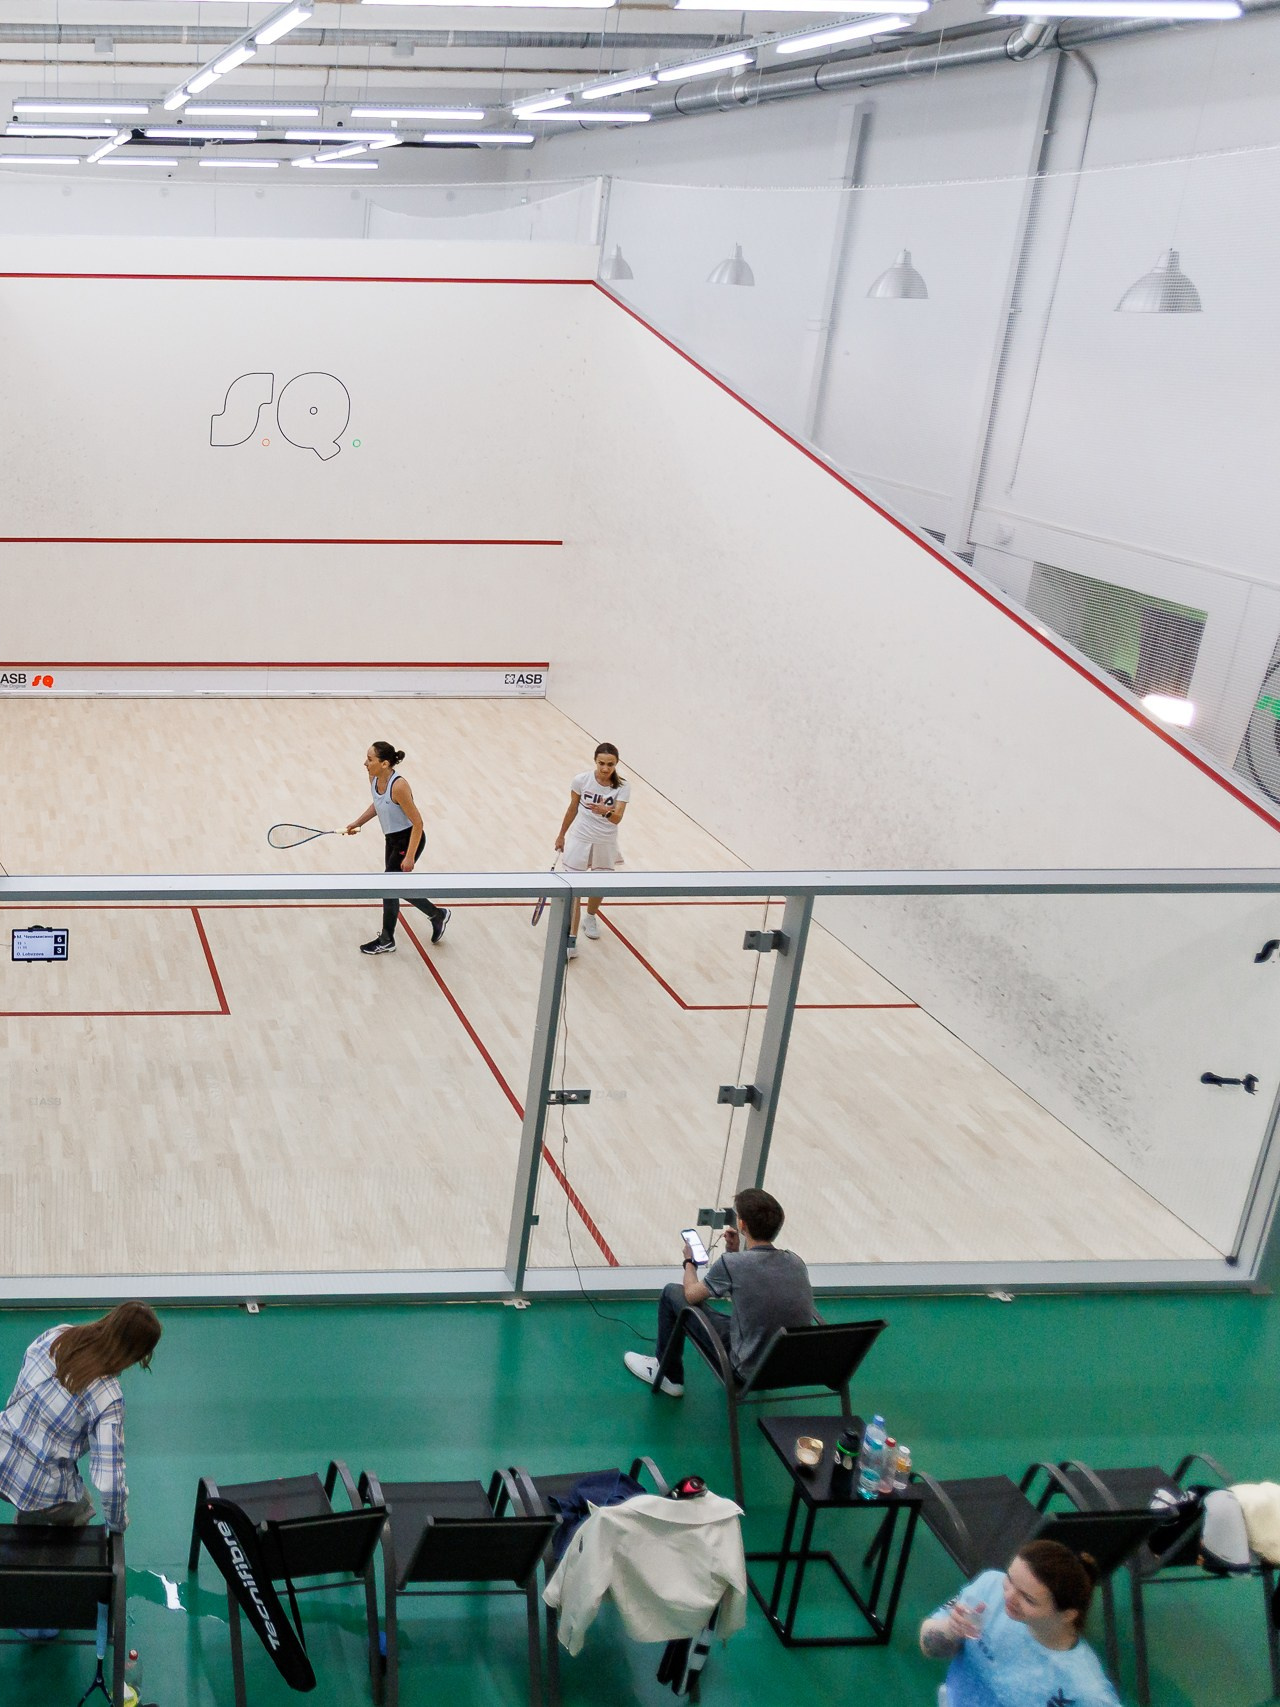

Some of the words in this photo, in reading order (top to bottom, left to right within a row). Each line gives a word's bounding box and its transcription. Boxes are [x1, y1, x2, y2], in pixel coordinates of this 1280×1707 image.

[0, 673, 27, 684] ASB
[516, 673, 543, 685] ASB
[216, 1519, 281, 1651] Tecnifibre
